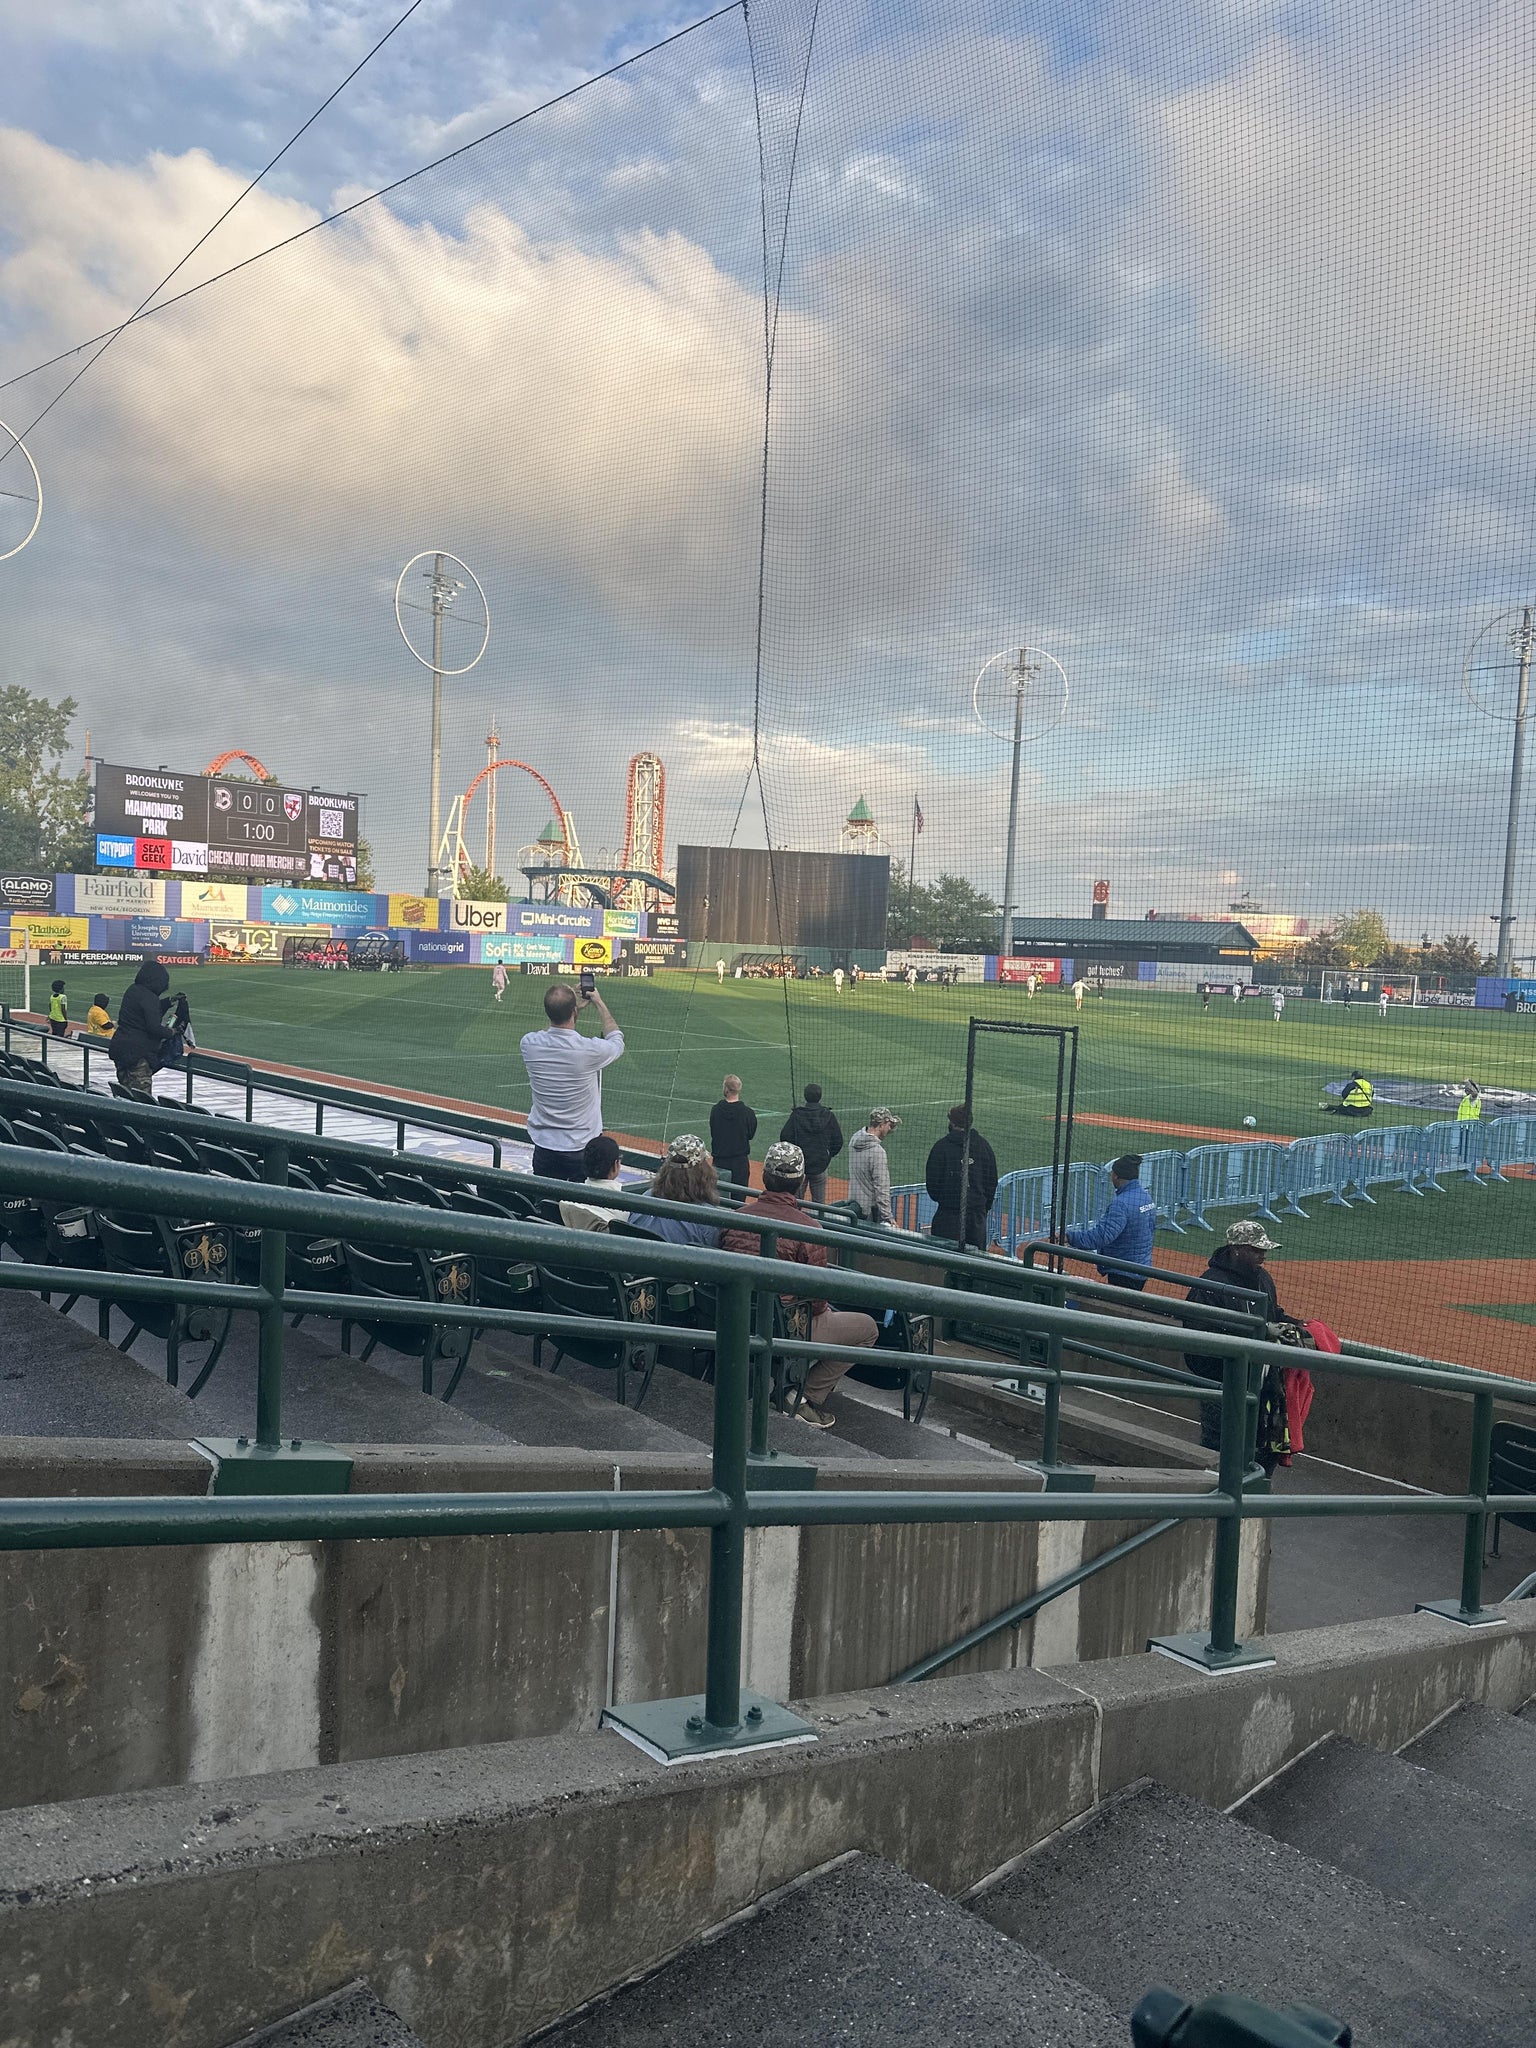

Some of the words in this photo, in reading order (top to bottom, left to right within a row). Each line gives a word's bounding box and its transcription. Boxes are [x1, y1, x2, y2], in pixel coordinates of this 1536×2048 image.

[125, 774, 175, 790] BROOKLYN
[124, 799, 184, 820] MAIMONIDES
[243, 795, 252, 810] 0
[266, 798, 275, 812] 0
[308, 795, 348, 810] BROOKLYN
[142, 818, 168, 836] PARK
[243, 822, 275, 841] 1:00
[142, 844, 165, 854] SEAT
[309, 845, 332, 853] TICKETS
[141, 853, 166, 864] GEEK
[172, 847, 207, 866] David
[208, 850, 234, 865] CHECK
[234, 852, 250, 867] OUT
[250, 853, 266, 868] OUR
[266, 854, 295, 870] MERCH!
[5, 880, 49, 891] ALAMO
[83, 878, 154, 899] Fairfield
[301, 897, 369, 913] Maimonides
[454, 903, 502, 928] Uber
[534, 912, 590, 927] Mini-Circuits
[418, 942, 464, 954] nationalgrid
[485, 943, 512, 957] SoFi
[634, 943, 669, 955] BROOKLYN
[63, 952, 80, 960] THE
[80, 952, 124, 961] PERECMAN
[124, 953, 144, 961] FIRM
[156, 955, 199, 966] SEATGEEK
[527, 962, 550, 975] David
[627, 965, 649, 977] David
[1447, 995, 1473, 1006] Uber
